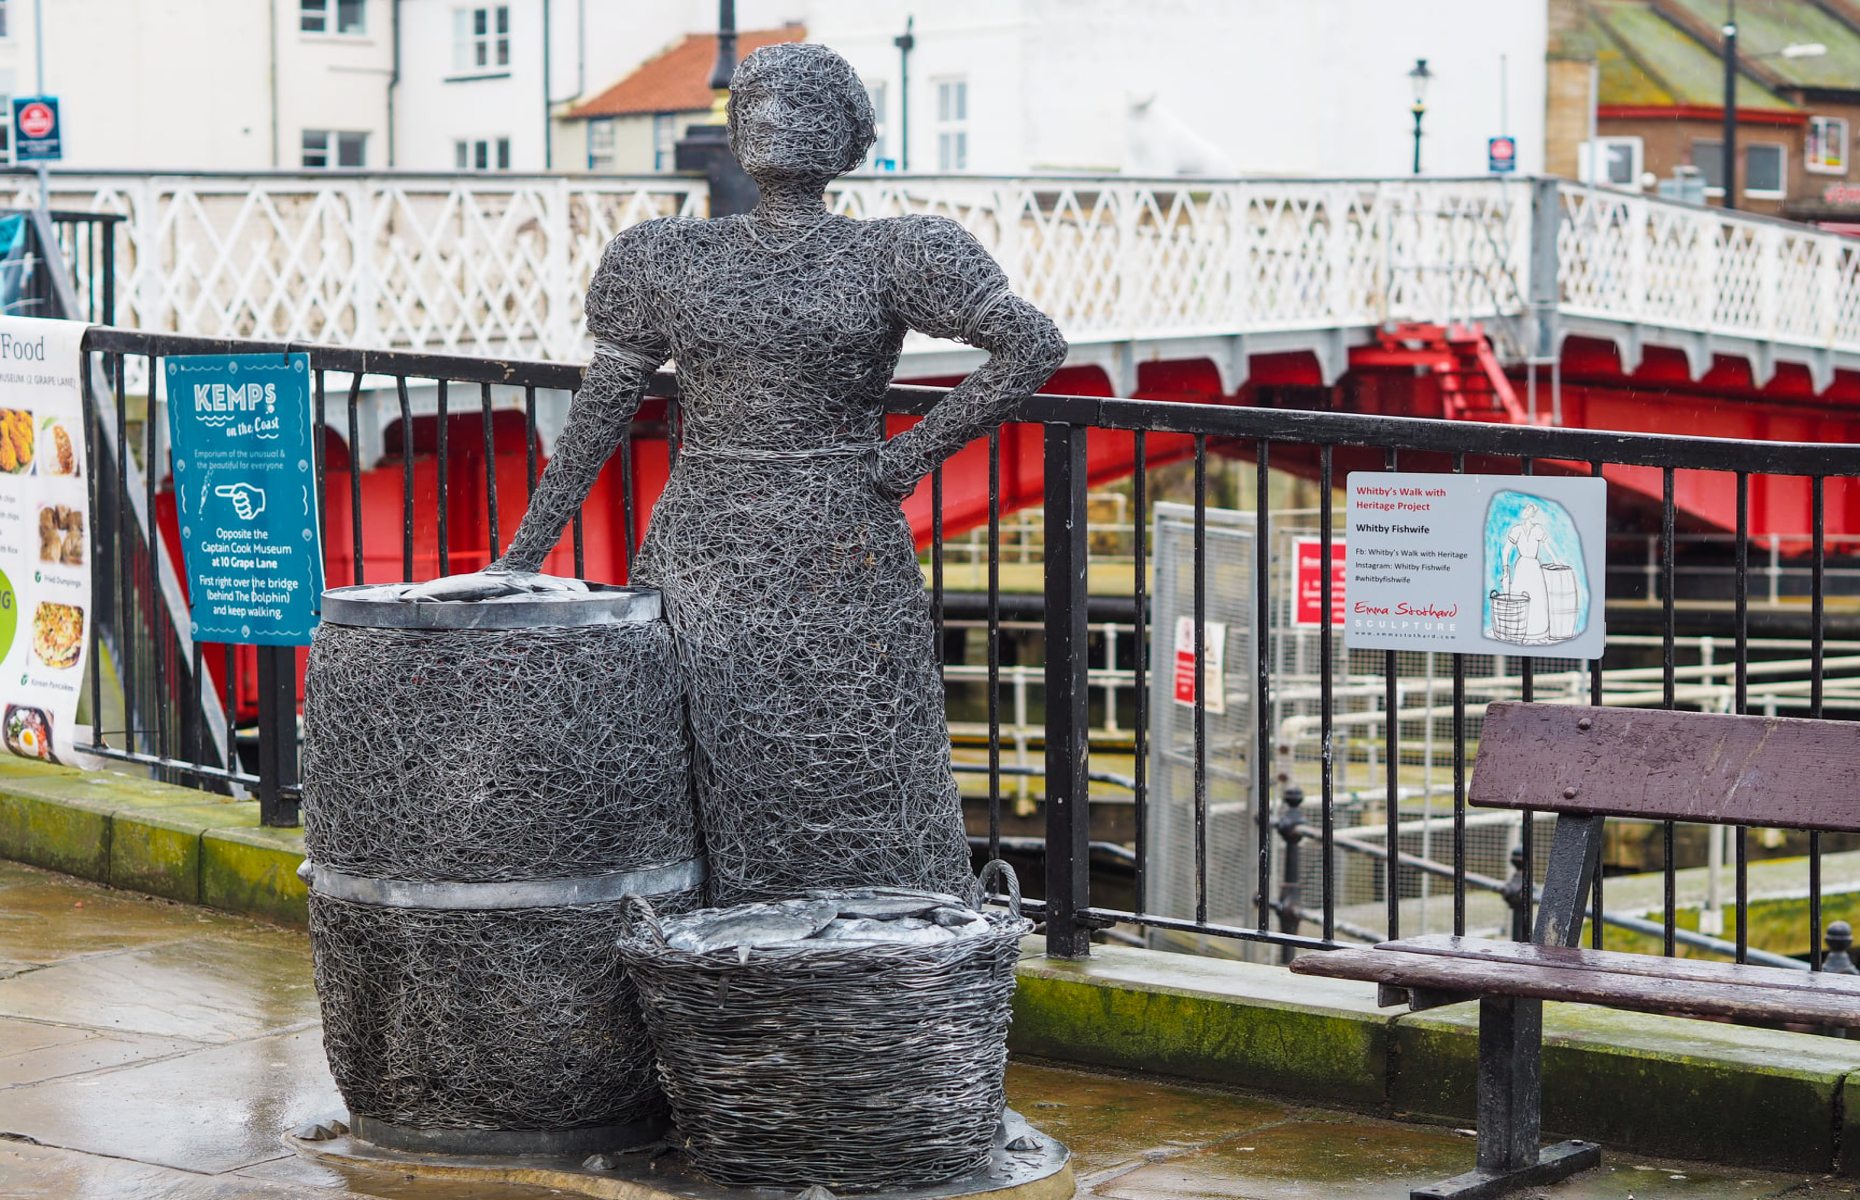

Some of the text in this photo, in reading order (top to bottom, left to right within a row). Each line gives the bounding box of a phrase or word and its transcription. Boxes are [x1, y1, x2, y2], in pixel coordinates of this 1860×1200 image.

[0, 333, 45, 361] Food
[194, 383, 277, 412] KEMPS
[226, 416, 279, 437] on the Coast
[194, 449, 285, 459] Emporium of the unusual &
[197, 460, 284, 471] the beautiful for everyone
[1356, 487, 1446, 497] Whitby's Walk with
[1356, 501, 1430, 512] Heritage Project
[216, 527, 269, 541] Opposite the
[1356, 523, 1430, 534] Whitby Fishwife
[201, 541, 292, 555] Captain Cook Museum
[1368, 548, 1399, 557] Whitby's
[1401, 549, 1418, 557] Walk
[1438, 551, 1468, 560] Heritage
[212, 557, 278, 571] at 10 Grape Lane
[1355, 562, 1392, 570] Instagram:
[1394, 562, 1420, 572] Whitby
[1421, 564, 1451, 572] Fishwife
[199, 575, 299, 591] First right over the bridge
[1355, 575, 1411, 584] #whitbyfishwife
[207, 589, 290, 605] (behind The Dolphin)
[213, 605, 283, 620] and keep walking.
[1354, 600, 1457, 619] Emma Stothard
[1355, 619, 1456, 631] SCULPTURE
